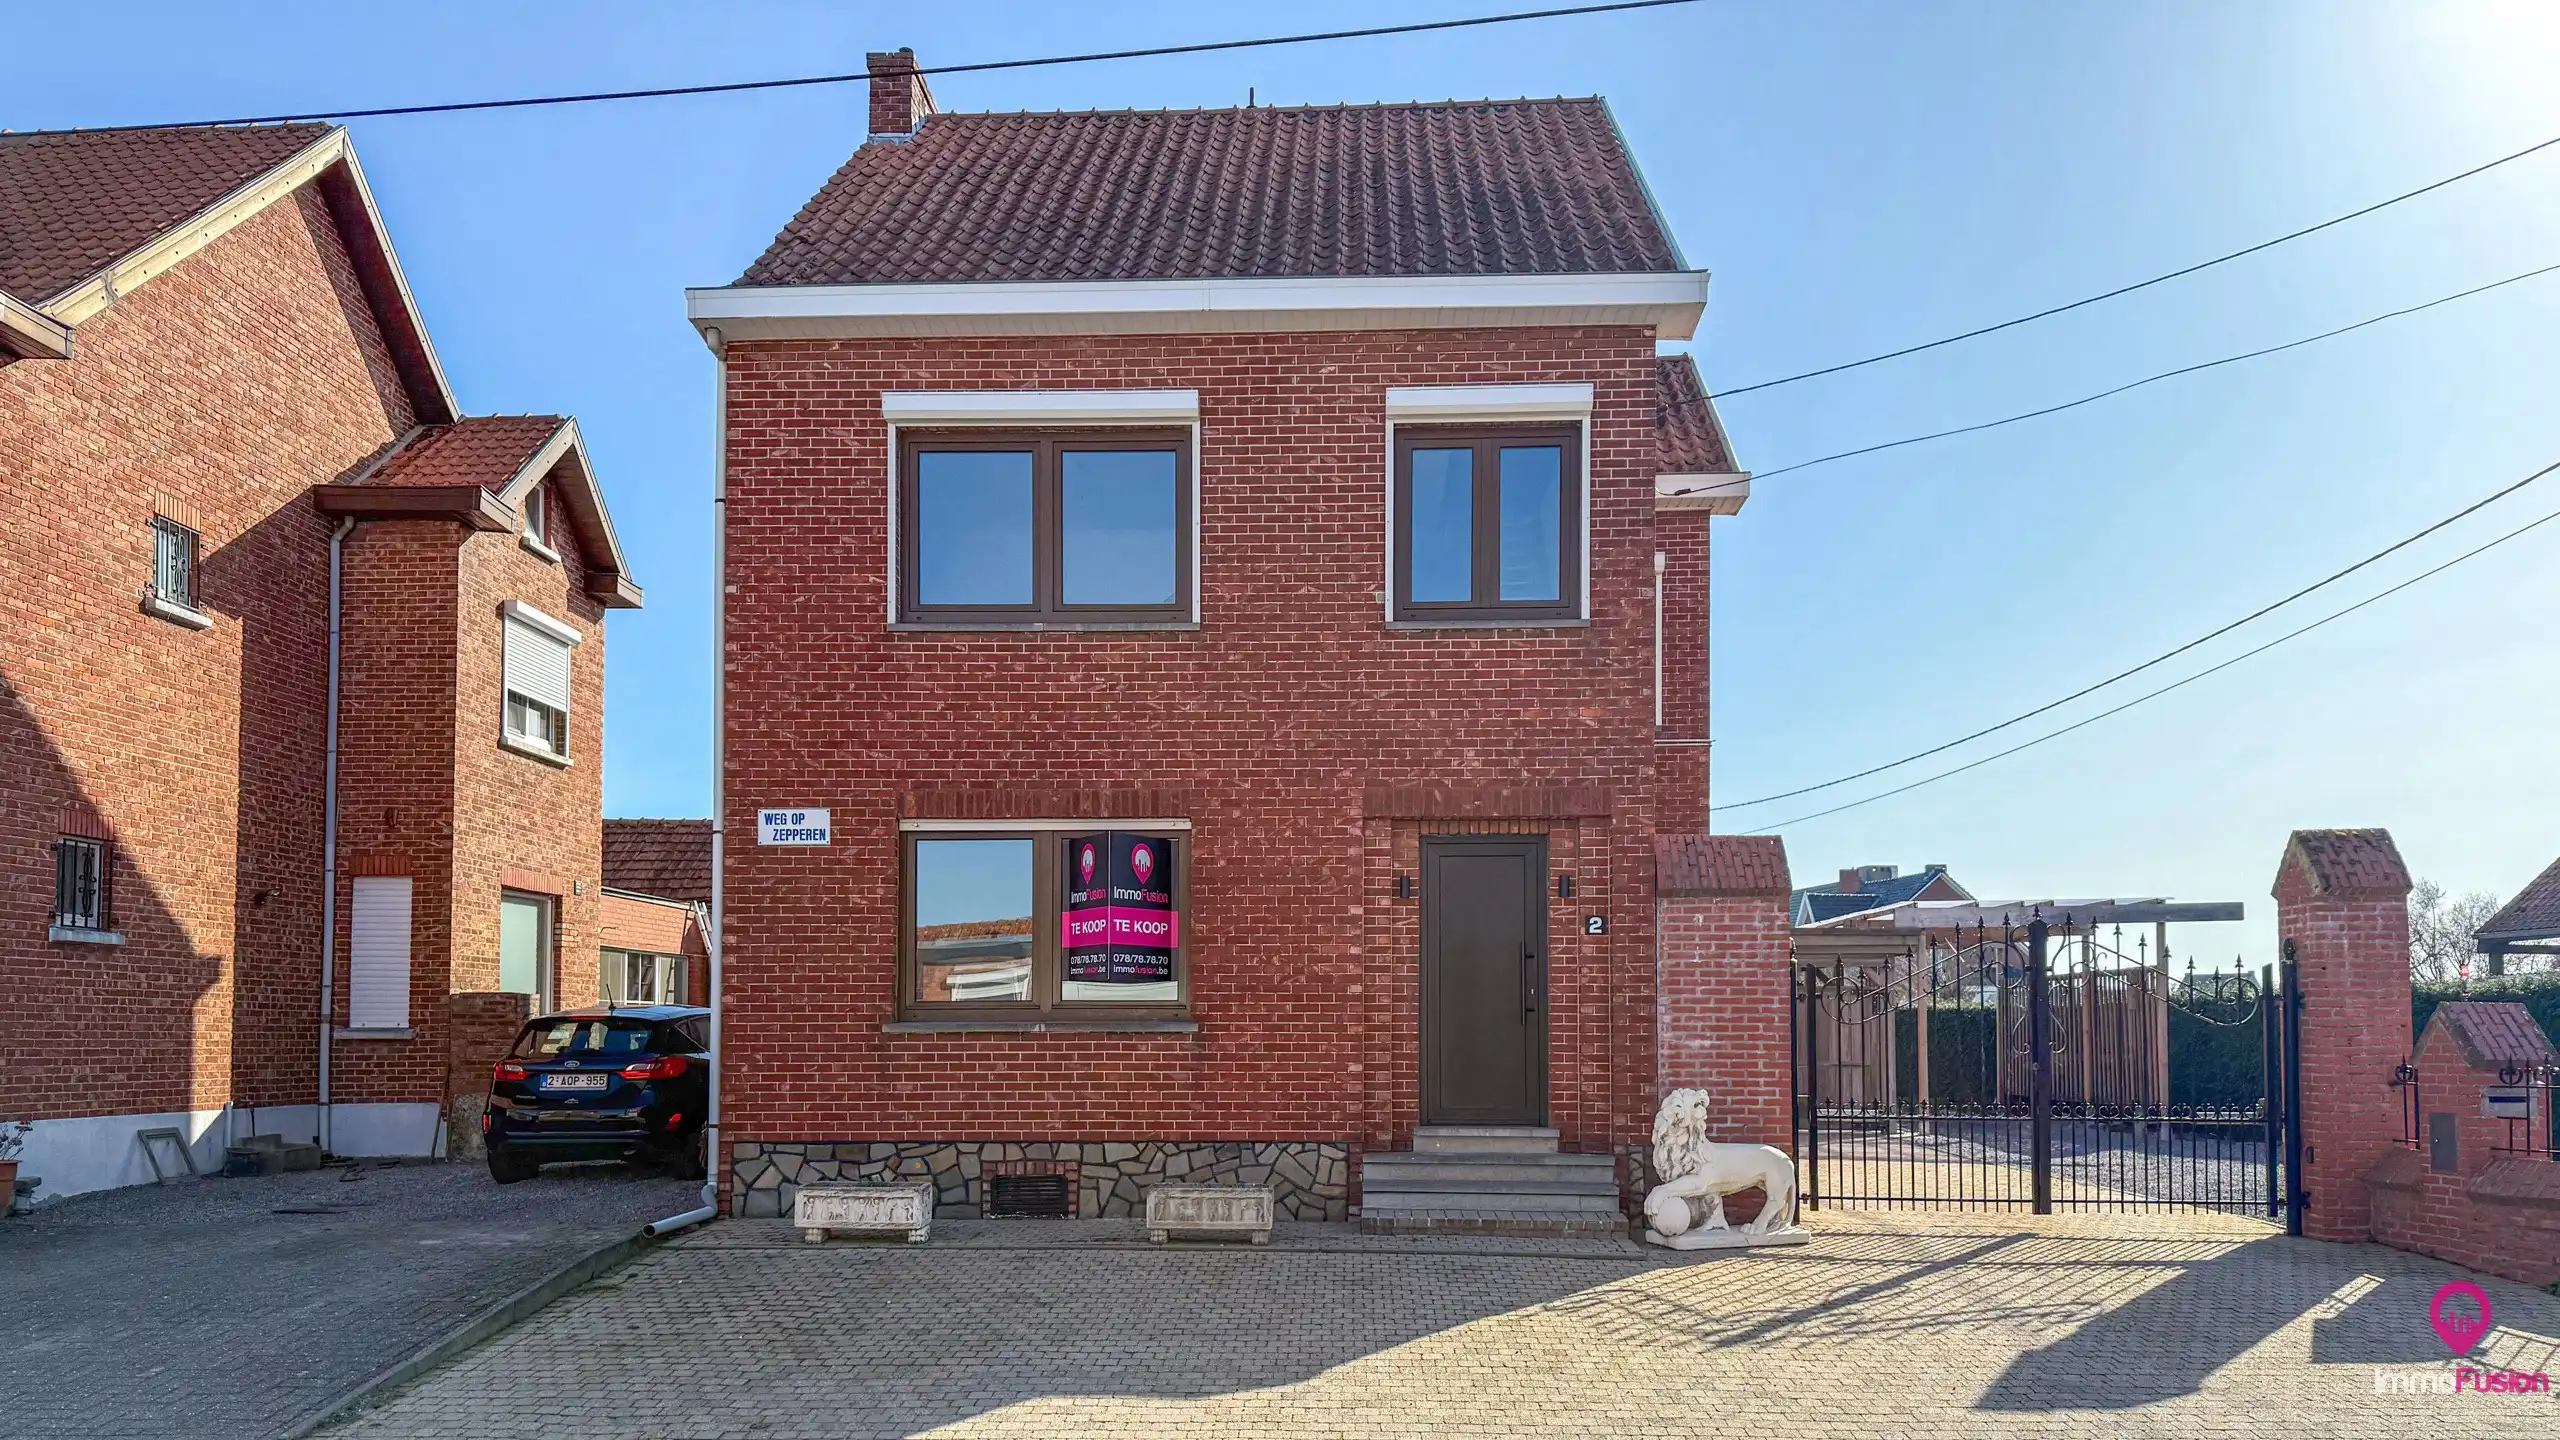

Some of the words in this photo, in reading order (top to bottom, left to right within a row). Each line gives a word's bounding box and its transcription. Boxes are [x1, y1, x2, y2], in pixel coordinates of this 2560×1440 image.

[764, 813, 787, 825] WEG
[791, 813, 805, 825] OP
[773, 828, 826, 841] ZEPPEREN
[1113, 886, 1168, 903] ImmoFusion
[1071, 922, 1081, 935] TE
[1082, 919, 1106, 934] KOOP
[1113, 919, 1131, 932] TE
[1134, 920, 1168, 935] KOOP
[1589, 916, 1602, 934] 2
[1070, 954, 1106, 964] 078/78.78.70
[1113, 954, 1168, 964] 078/78.78.70
[1113, 965, 1168, 975] immofusion.be
